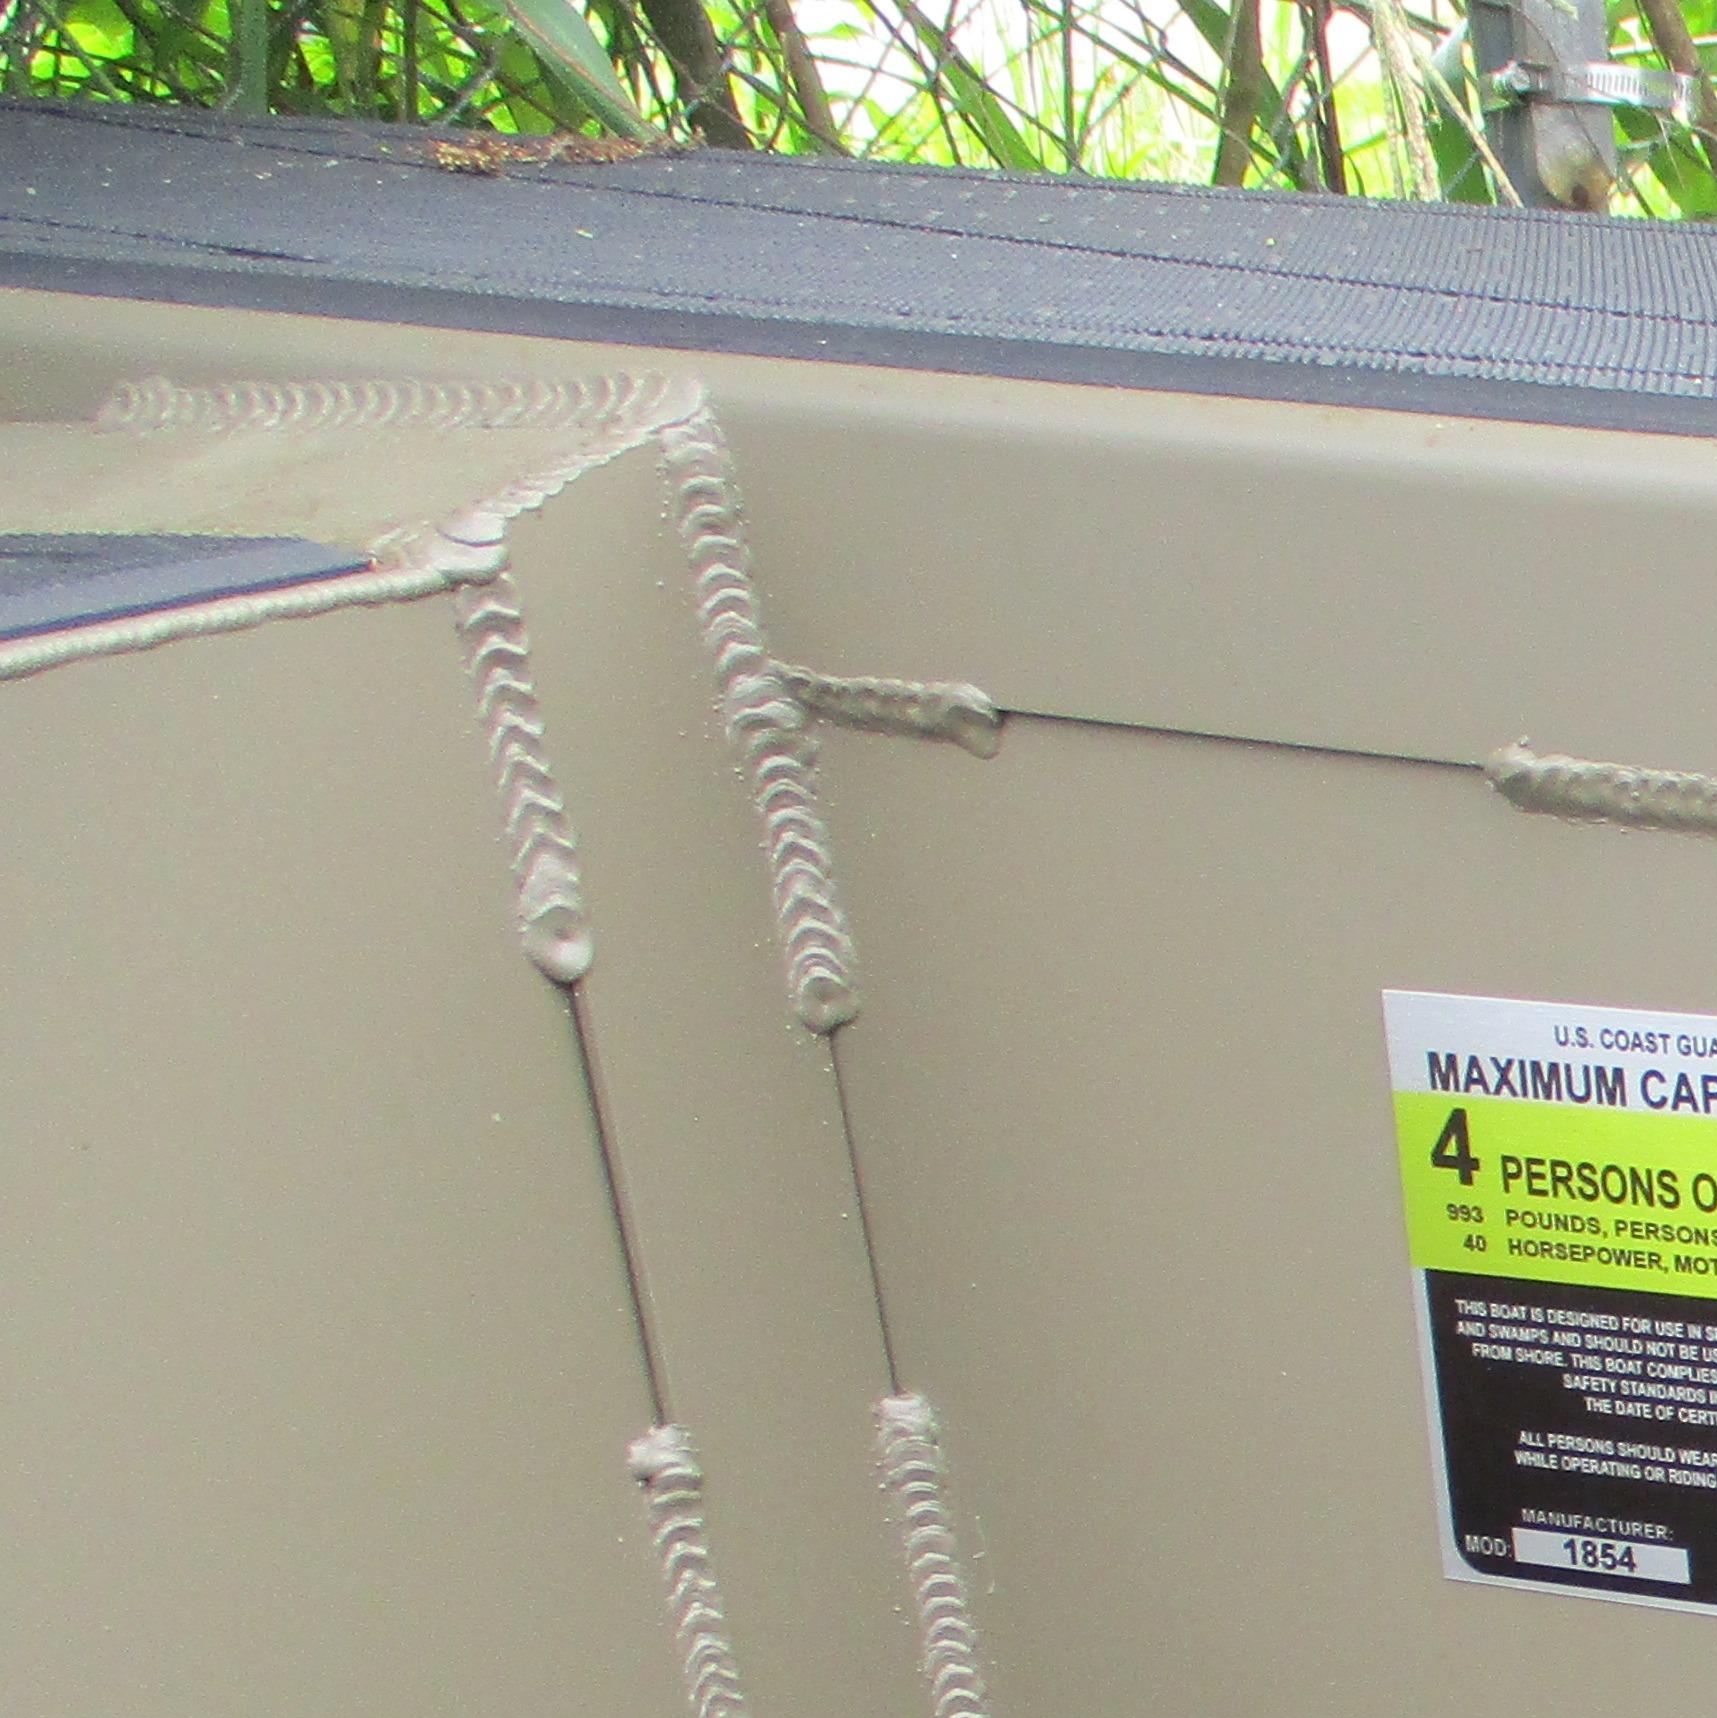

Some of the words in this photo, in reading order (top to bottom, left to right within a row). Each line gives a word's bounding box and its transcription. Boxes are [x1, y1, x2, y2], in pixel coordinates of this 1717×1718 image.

[1554, 1024, 1594, 1049] U.S.
[1599, 1028, 1671, 1055] COAST
[1427, 1051, 1627, 1107] MAXIMUM
[1431, 1107, 1480, 1186] 4
[1501, 1155, 1681, 1209] PERSONS
[1446, 1203, 1484, 1223] 993
[1505, 1208, 1608, 1239] POUNDS,
[1463, 1234, 1487, 1252] 40
[1507, 1237, 1669, 1273] HORSEPOWER,
[1454, 1299, 1487, 1317] THIS
[1489, 1303, 1527, 1321] BOAT
[1530, 1307, 1545, 1323] IS
[1547, 1309, 1619, 1331] DESIGNED
[1622, 1316, 1652, 1334] FOR
[1655, 1320, 1684, 1338] USE
[1687, 1324, 1702, 1340] IN
[1456, 1320, 1486, 1337] AND
[1488, 1324, 1549, 1344] SWAMPS
[1552, 1332, 1582, 1348] AND
[1584, 1334, 1643, 1355] SHOULD
[1646, 1340, 1676, 1358] NOT
[1678, 1344, 1700, 1361] BE
[1471, 1342, 1513, 1361] FROM
[1515, 1347, 1567, 1368] SHORE.
[1570, 1352, 1602, 1371] THIS
[1605, 1357, 1643, 1375] BOAT
[1562, 1373, 1617, 1393] SAFETY
[1620, 1379, 1706, 1404] STANDARDS
[1583, 1396, 1613, 1413] THE
[1615, 1400, 1653, 1419] DATE
[1655, 1404, 1675, 1421] OF
[1518, 1430, 1545, 1447] ALL
[1547, 1433, 1614, 1456] PERSONS
[1616, 1442, 1676, 1463] SHOULD
[1513, 1450, 1558, 1469] WHILE
[1561, 1456, 1642, 1479] OPERATING
[1644, 1466, 1667, 1482] OR
[1669, 1468, 1717, 1489] RIDING
[1521, 1508, 1674, 1541] MANUFACTURER:
[1464, 1534, 1513, 1558] MOD:
[1563, 1537, 1638, 1573] 1854
